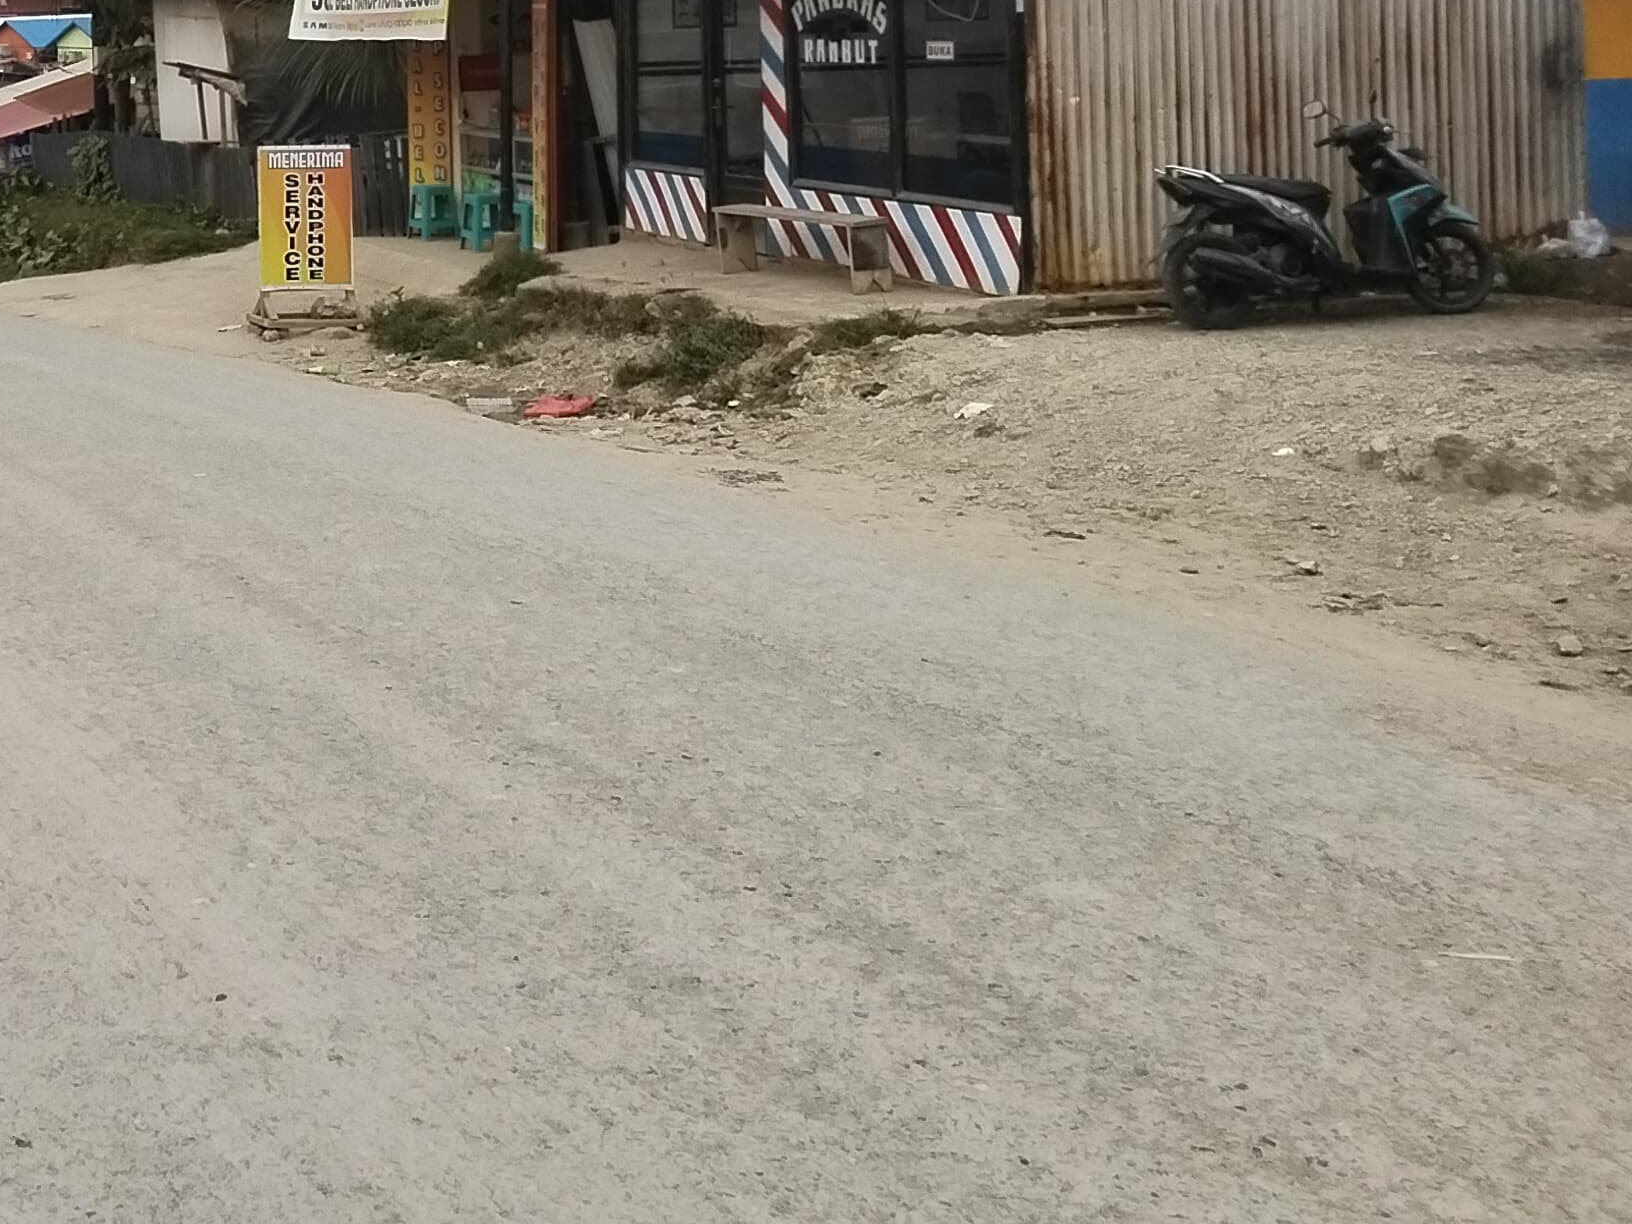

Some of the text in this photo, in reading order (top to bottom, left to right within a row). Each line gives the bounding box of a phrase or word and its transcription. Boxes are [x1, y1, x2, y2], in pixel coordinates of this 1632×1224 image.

[268, 152, 344, 168] MENERIMA
[284, 173, 301, 281] SERVICE
[306, 172, 325, 280] HANDPHONE
